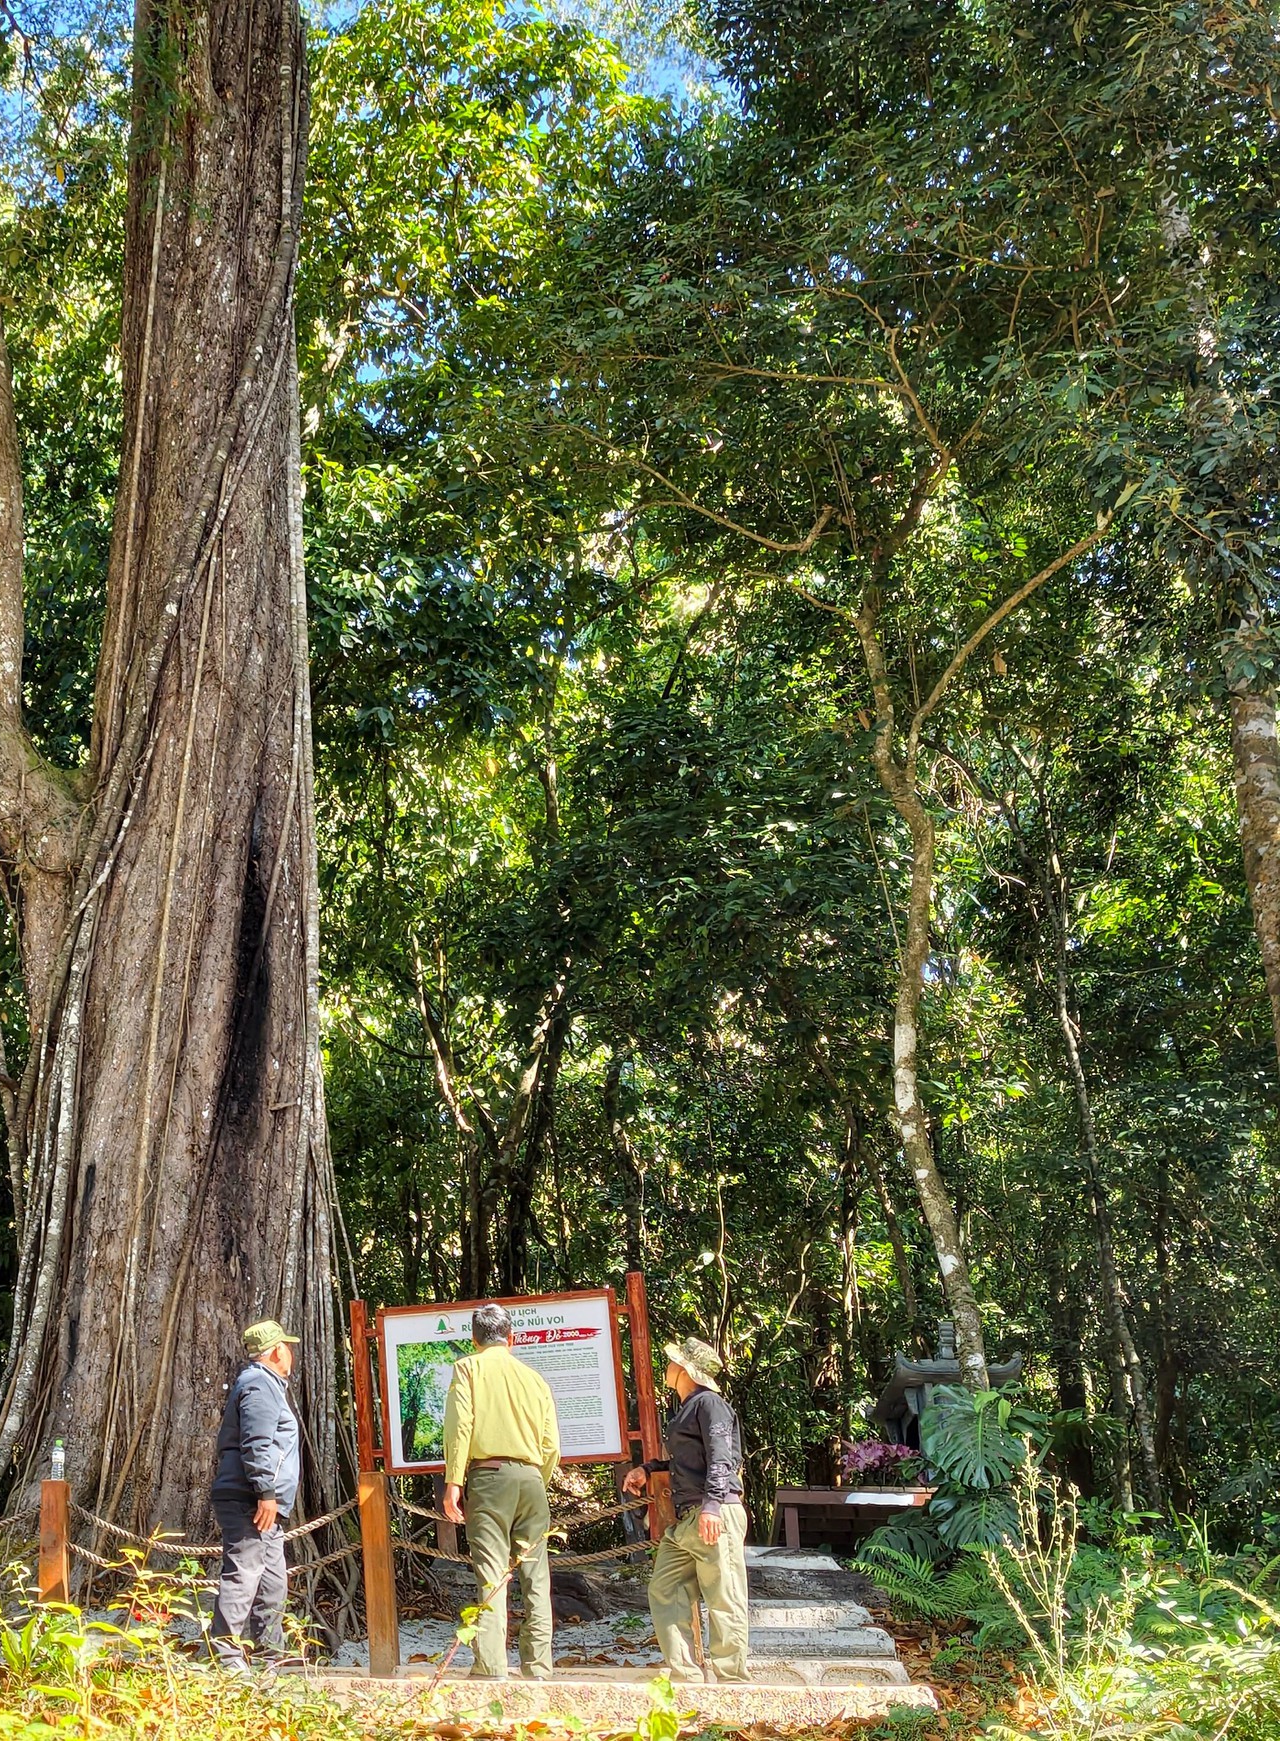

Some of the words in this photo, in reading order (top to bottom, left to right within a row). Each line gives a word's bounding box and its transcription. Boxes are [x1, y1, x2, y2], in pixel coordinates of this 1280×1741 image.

[518, 1308, 537, 1318] LỊCH
[527, 1315, 544, 1326] NÚI
[546, 1315, 564, 1325] VOI
